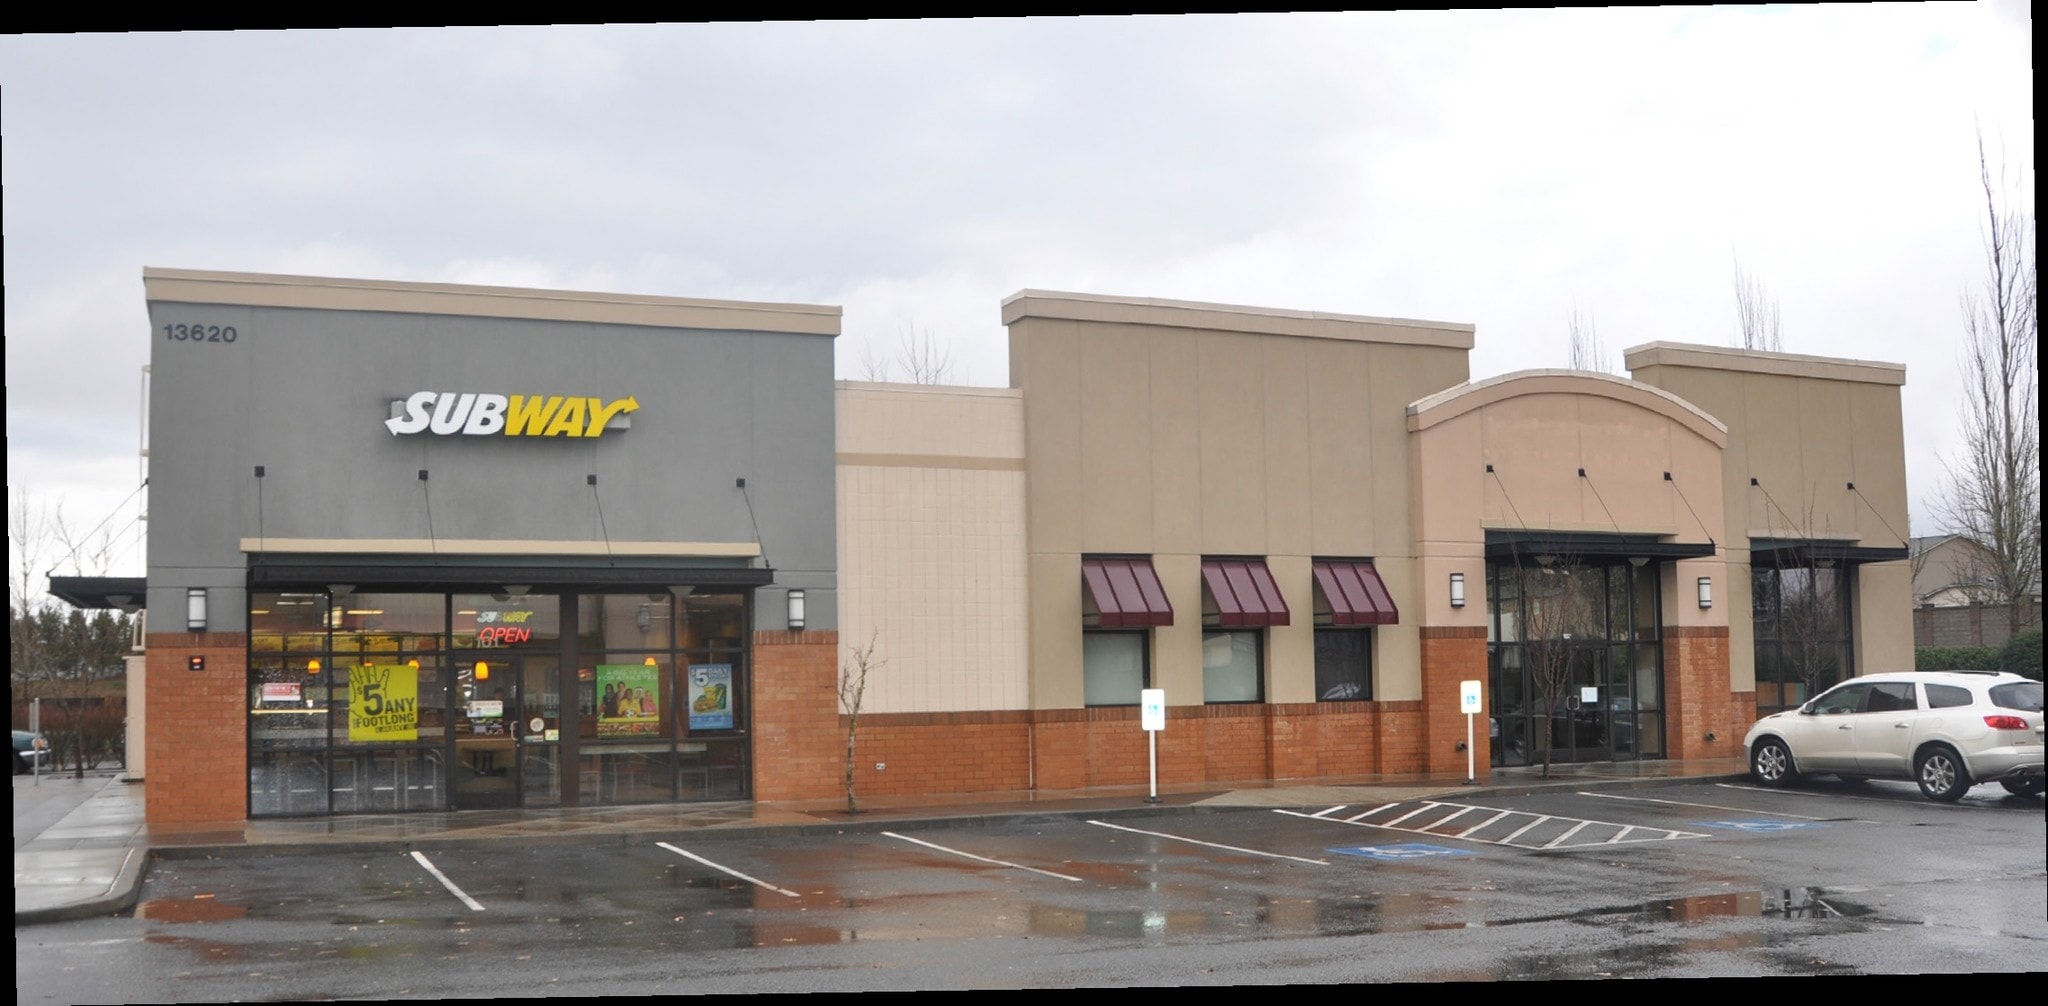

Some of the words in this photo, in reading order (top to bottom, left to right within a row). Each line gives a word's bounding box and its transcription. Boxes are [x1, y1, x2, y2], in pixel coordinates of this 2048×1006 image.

[164, 323, 238, 343] 13620
[385, 391, 640, 437] SUBWAY
[480, 626, 531, 643] OPEN
[384, 697, 415, 715] ANY
[355, 713, 415, 729] FOOTLONG
